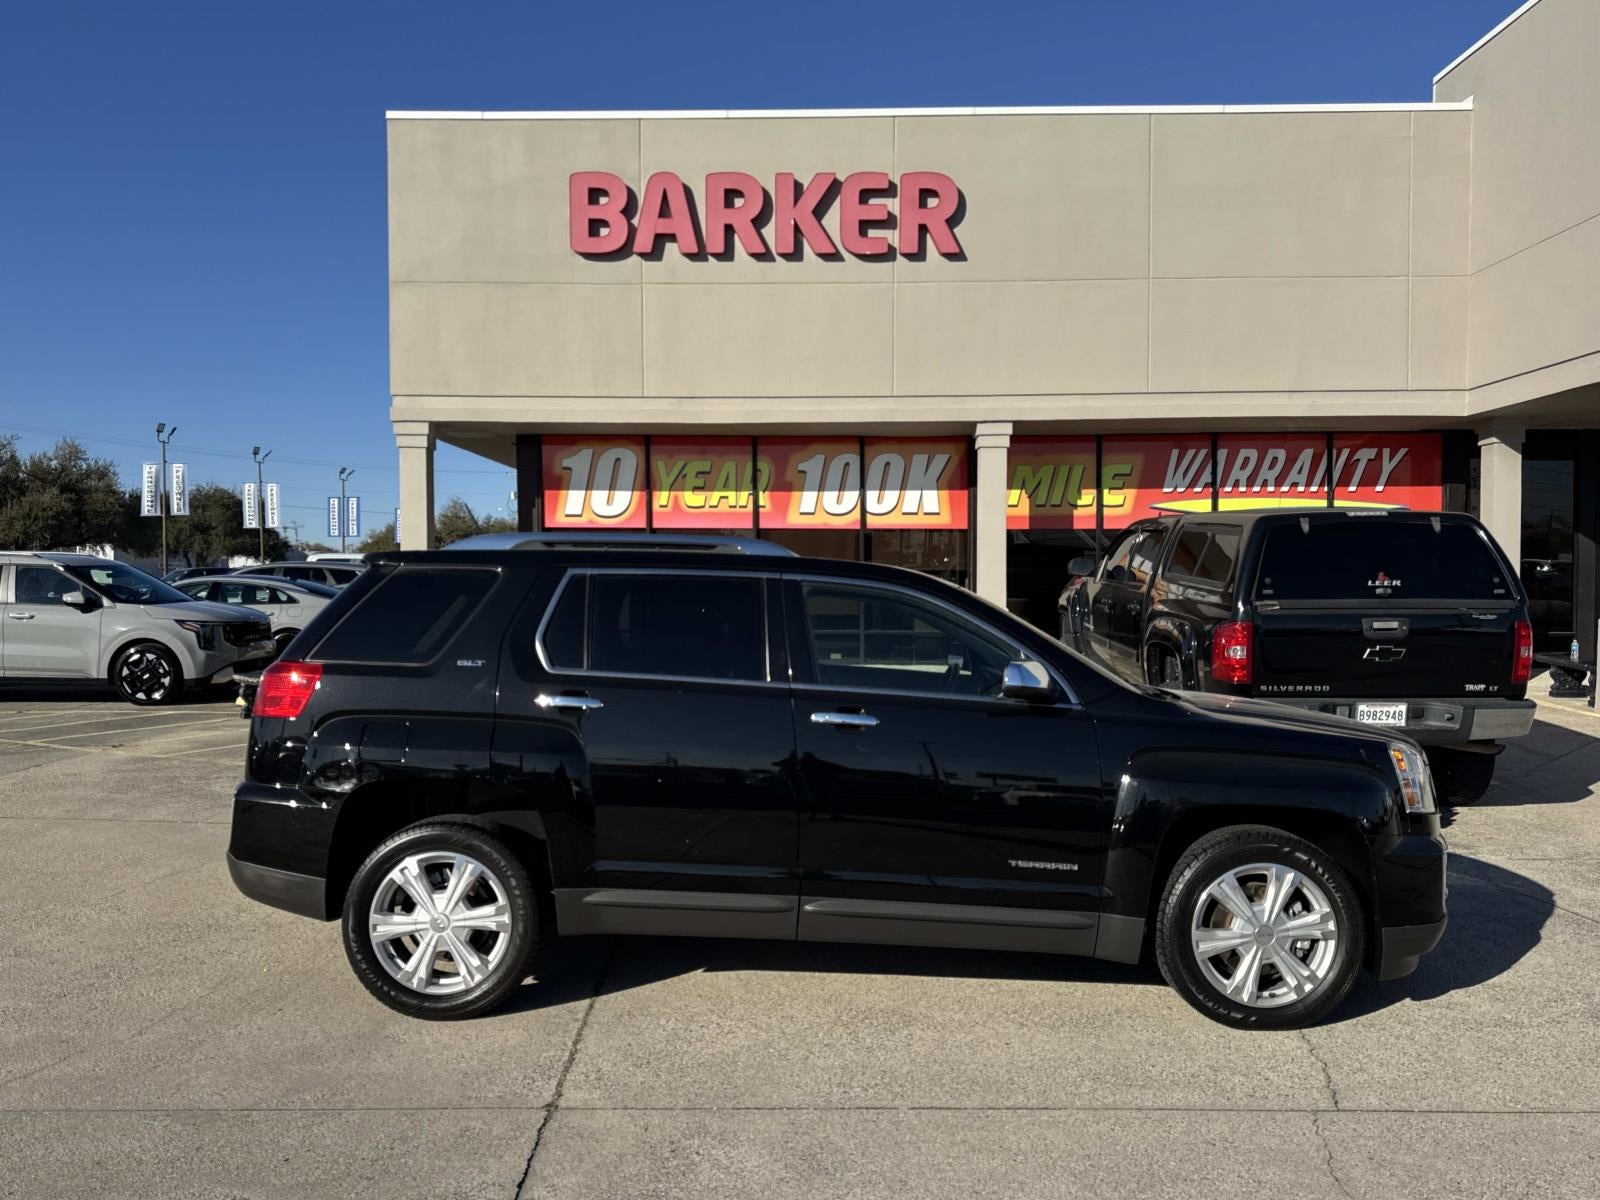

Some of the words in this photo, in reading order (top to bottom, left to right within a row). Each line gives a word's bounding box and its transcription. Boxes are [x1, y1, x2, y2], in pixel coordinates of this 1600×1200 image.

[569, 170, 967, 260] BARKER
[560, 446, 640, 518] 10
[654, 459, 771, 509] YEAR
[796, 452, 951, 516] 100K
[1007, 463, 1134, 508] MILE
[1161, 447, 1410, 494] WARRANTY
[1367, 579, 1402, 587] LEER
[1359, 710, 1404, 721] B982948
[1007, 859, 1079, 871] TERRAIN
